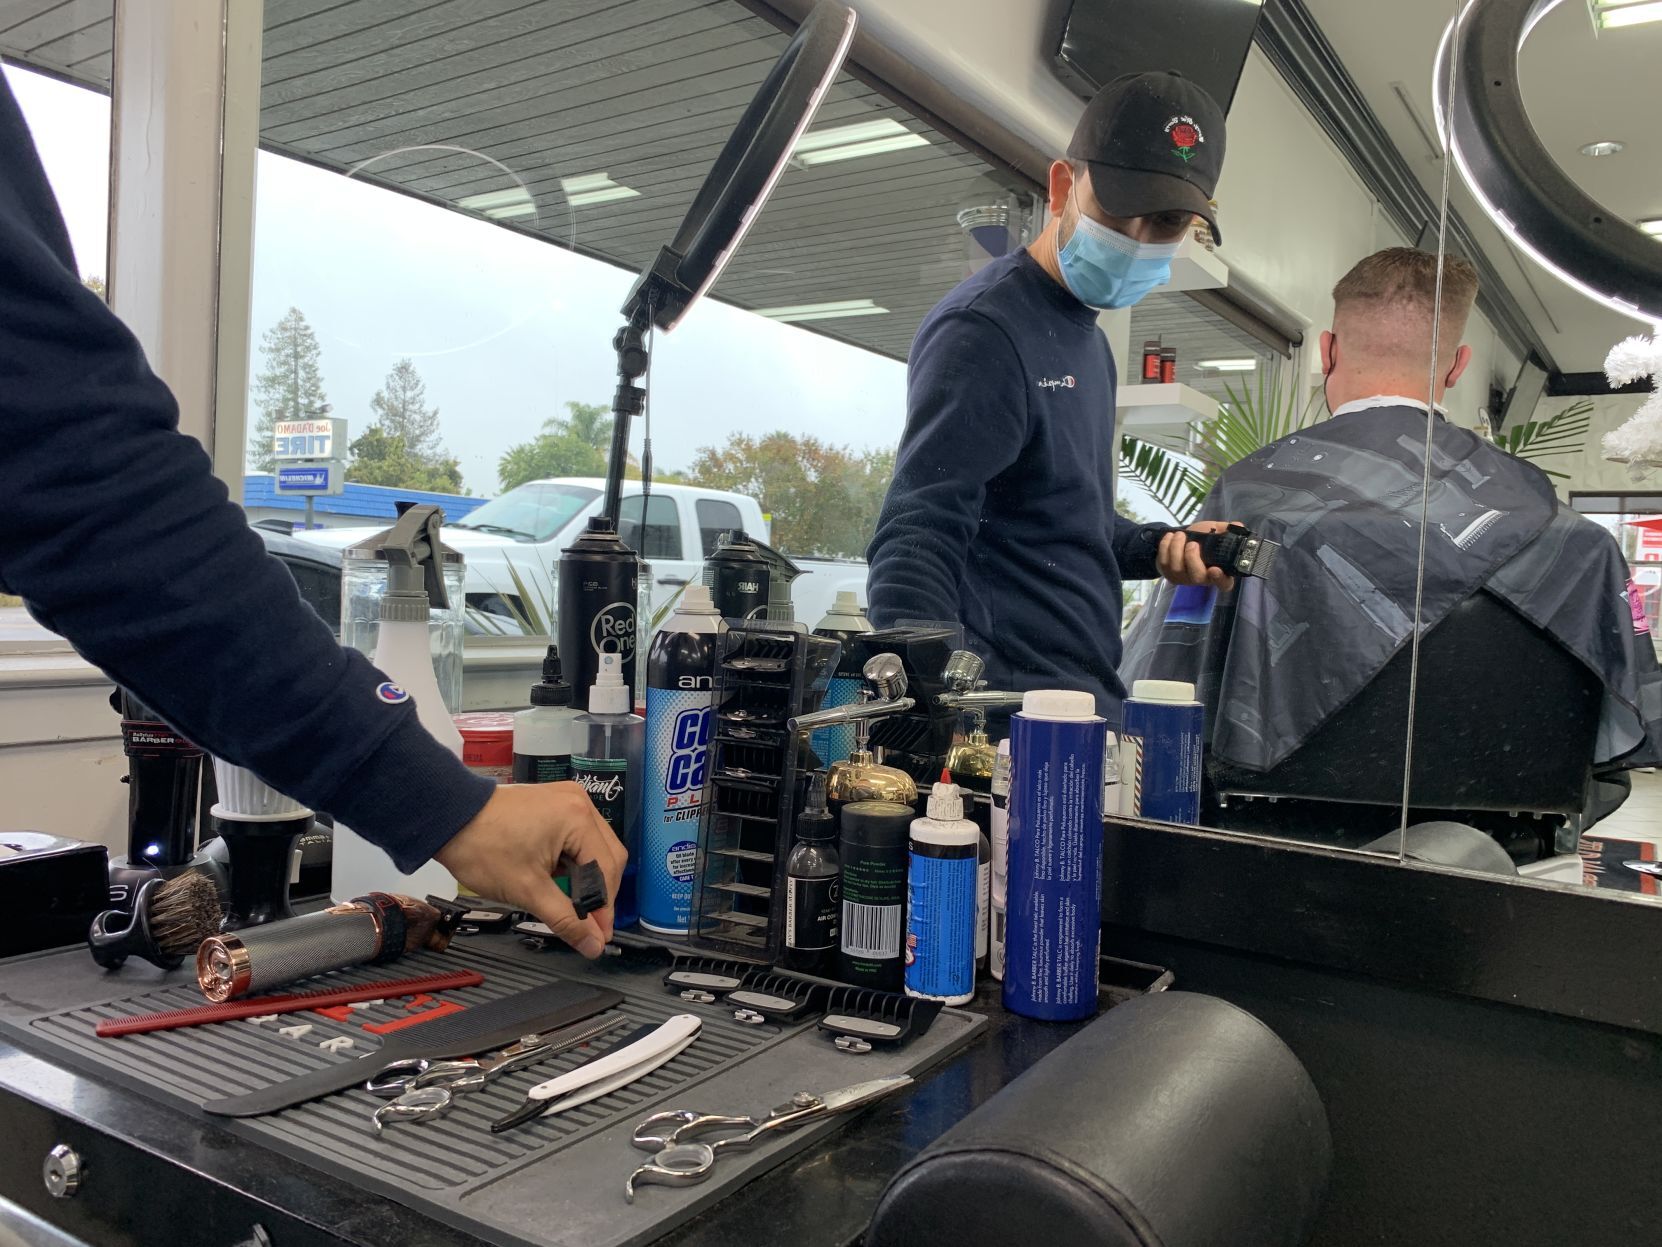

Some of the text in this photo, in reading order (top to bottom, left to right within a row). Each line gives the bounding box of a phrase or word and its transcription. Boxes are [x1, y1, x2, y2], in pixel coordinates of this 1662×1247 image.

[601, 613, 634, 636] Red
[600, 635, 635, 654] One
[1058, 865, 1066, 881] Johnny
